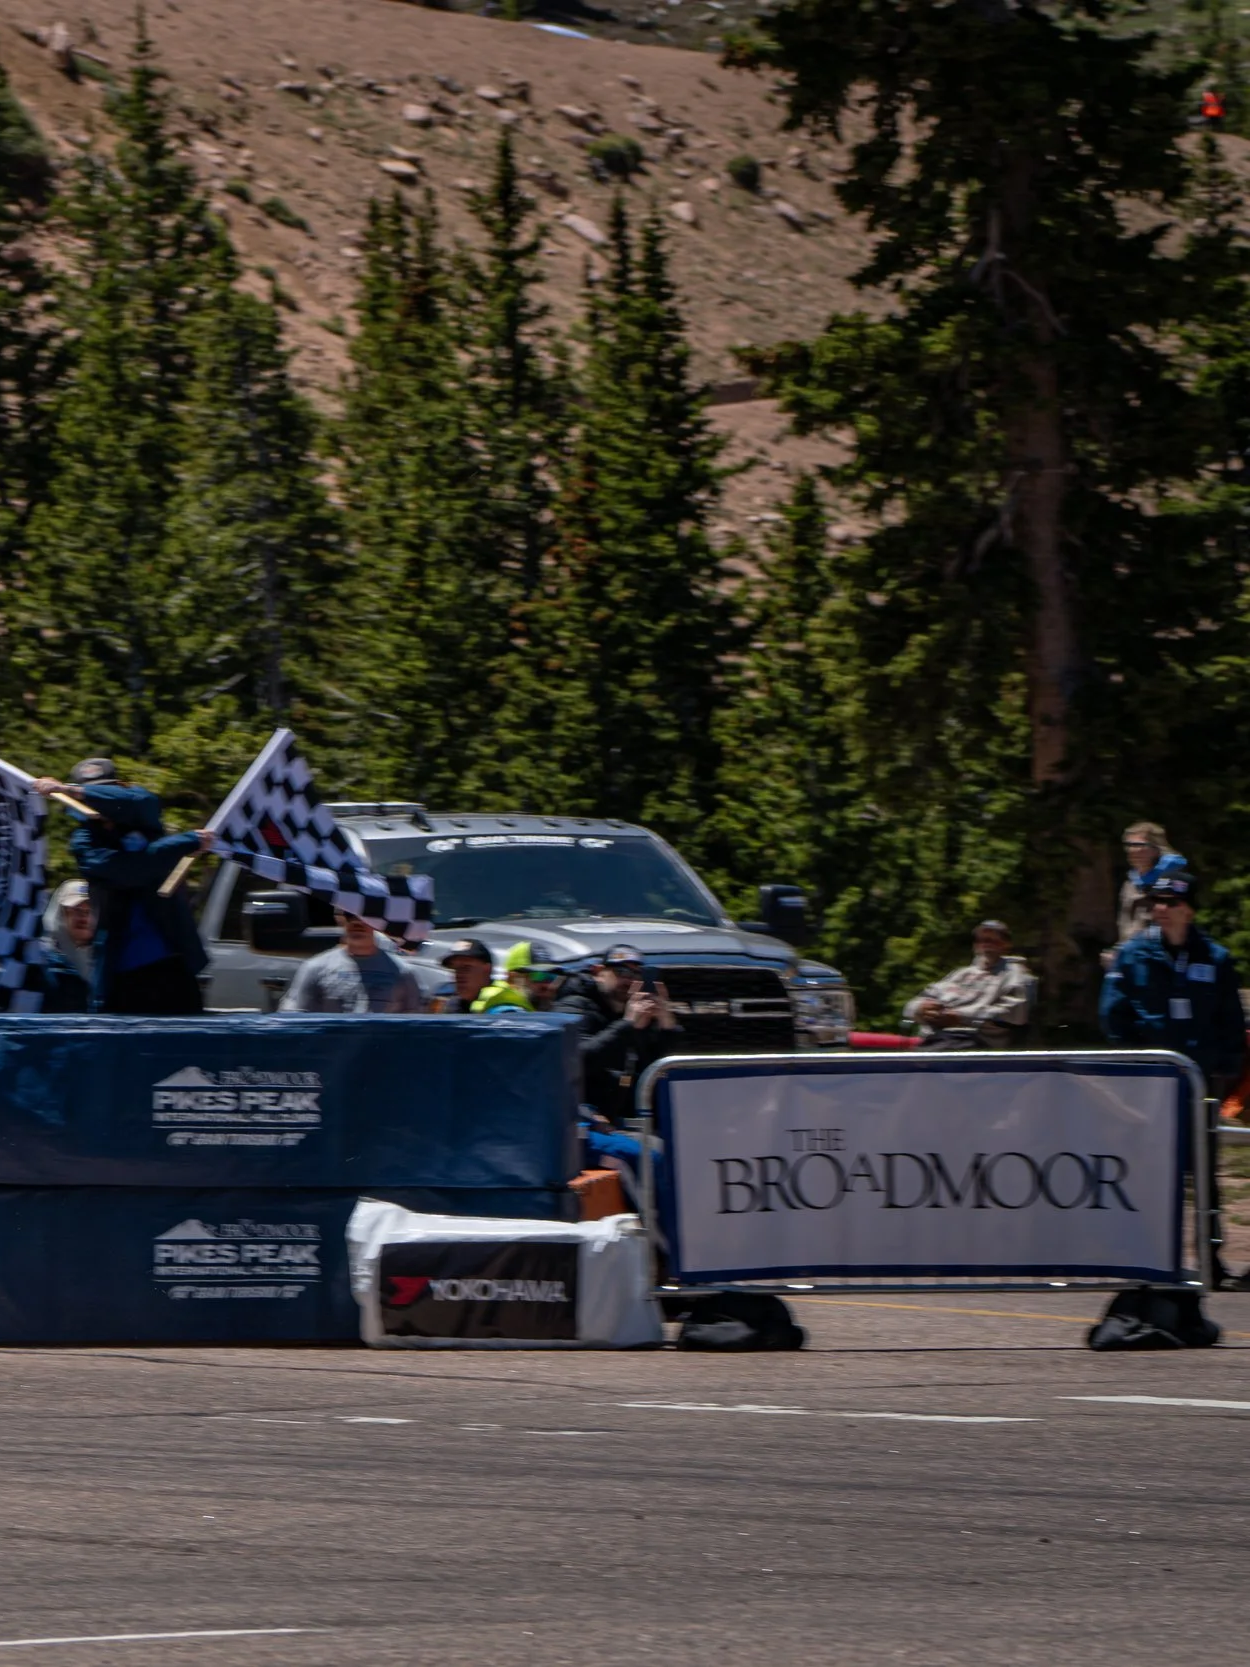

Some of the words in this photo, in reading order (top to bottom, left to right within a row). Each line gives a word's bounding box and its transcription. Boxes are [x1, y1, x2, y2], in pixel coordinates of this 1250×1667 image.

[152, 1091, 239, 1111] PIKES
[239, 1091, 322, 1111] PEAK
[785, 1127, 848, 1152] THE
[709, 1151, 1140, 1215] BROADMOOR
[153, 1244, 240, 1264] PIKES
[240, 1244, 321, 1264] PEAK
[428, 1279, 570, 1302] YOKOHAMA
